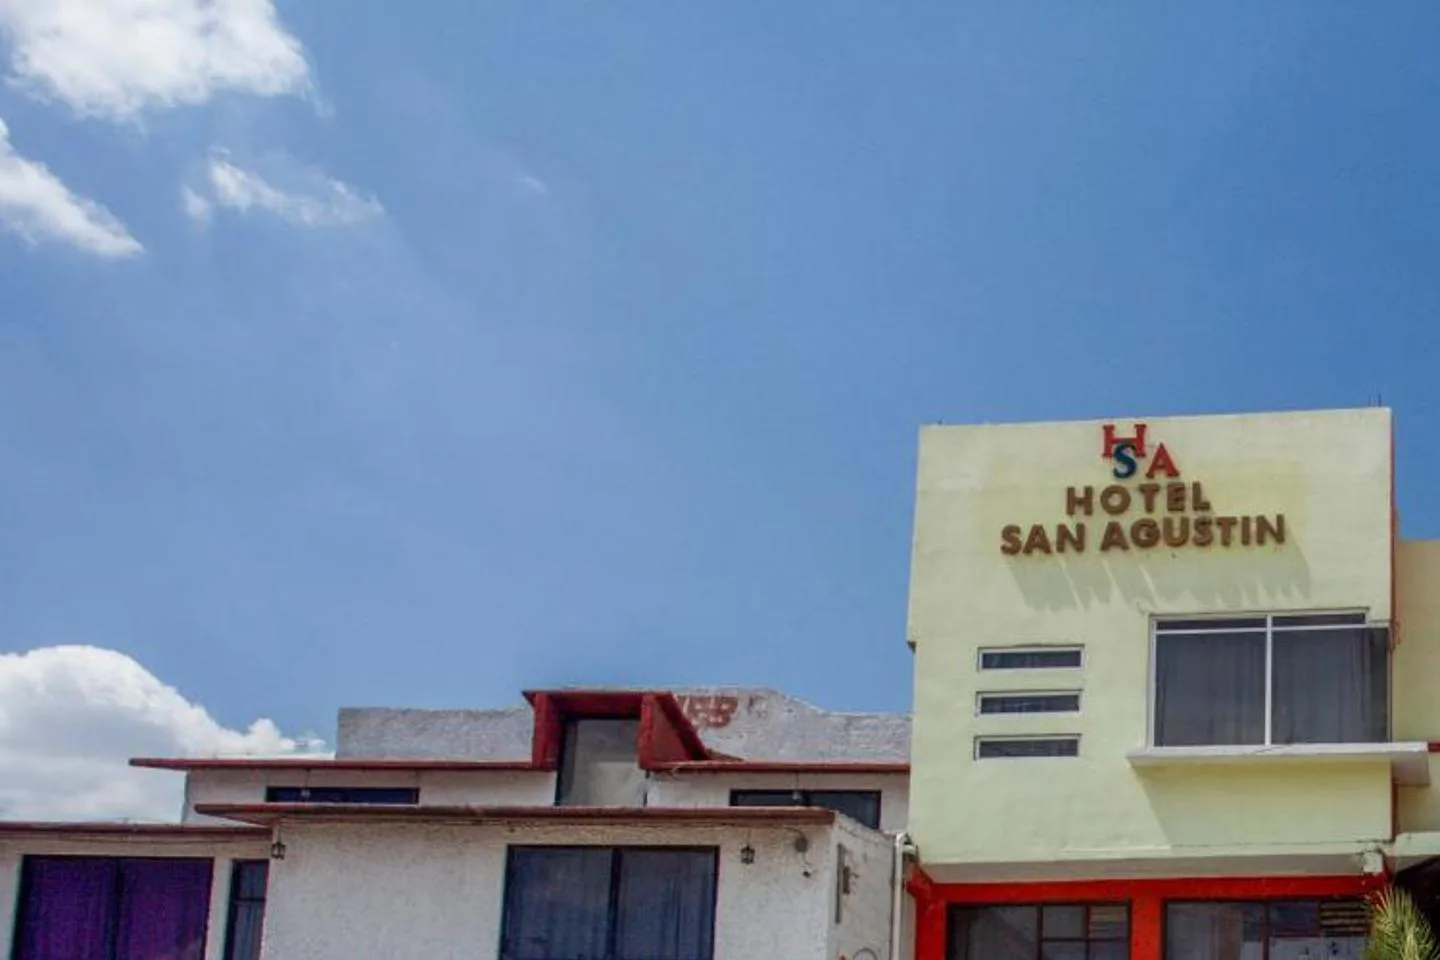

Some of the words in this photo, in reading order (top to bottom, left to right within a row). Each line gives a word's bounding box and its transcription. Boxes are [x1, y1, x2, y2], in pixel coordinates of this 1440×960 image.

[1065, 481, 1212, 516] HOTEL
[1000, 522, 1087, 556] SAN
[1099, 513, 1286, 551] AGUSTIN
